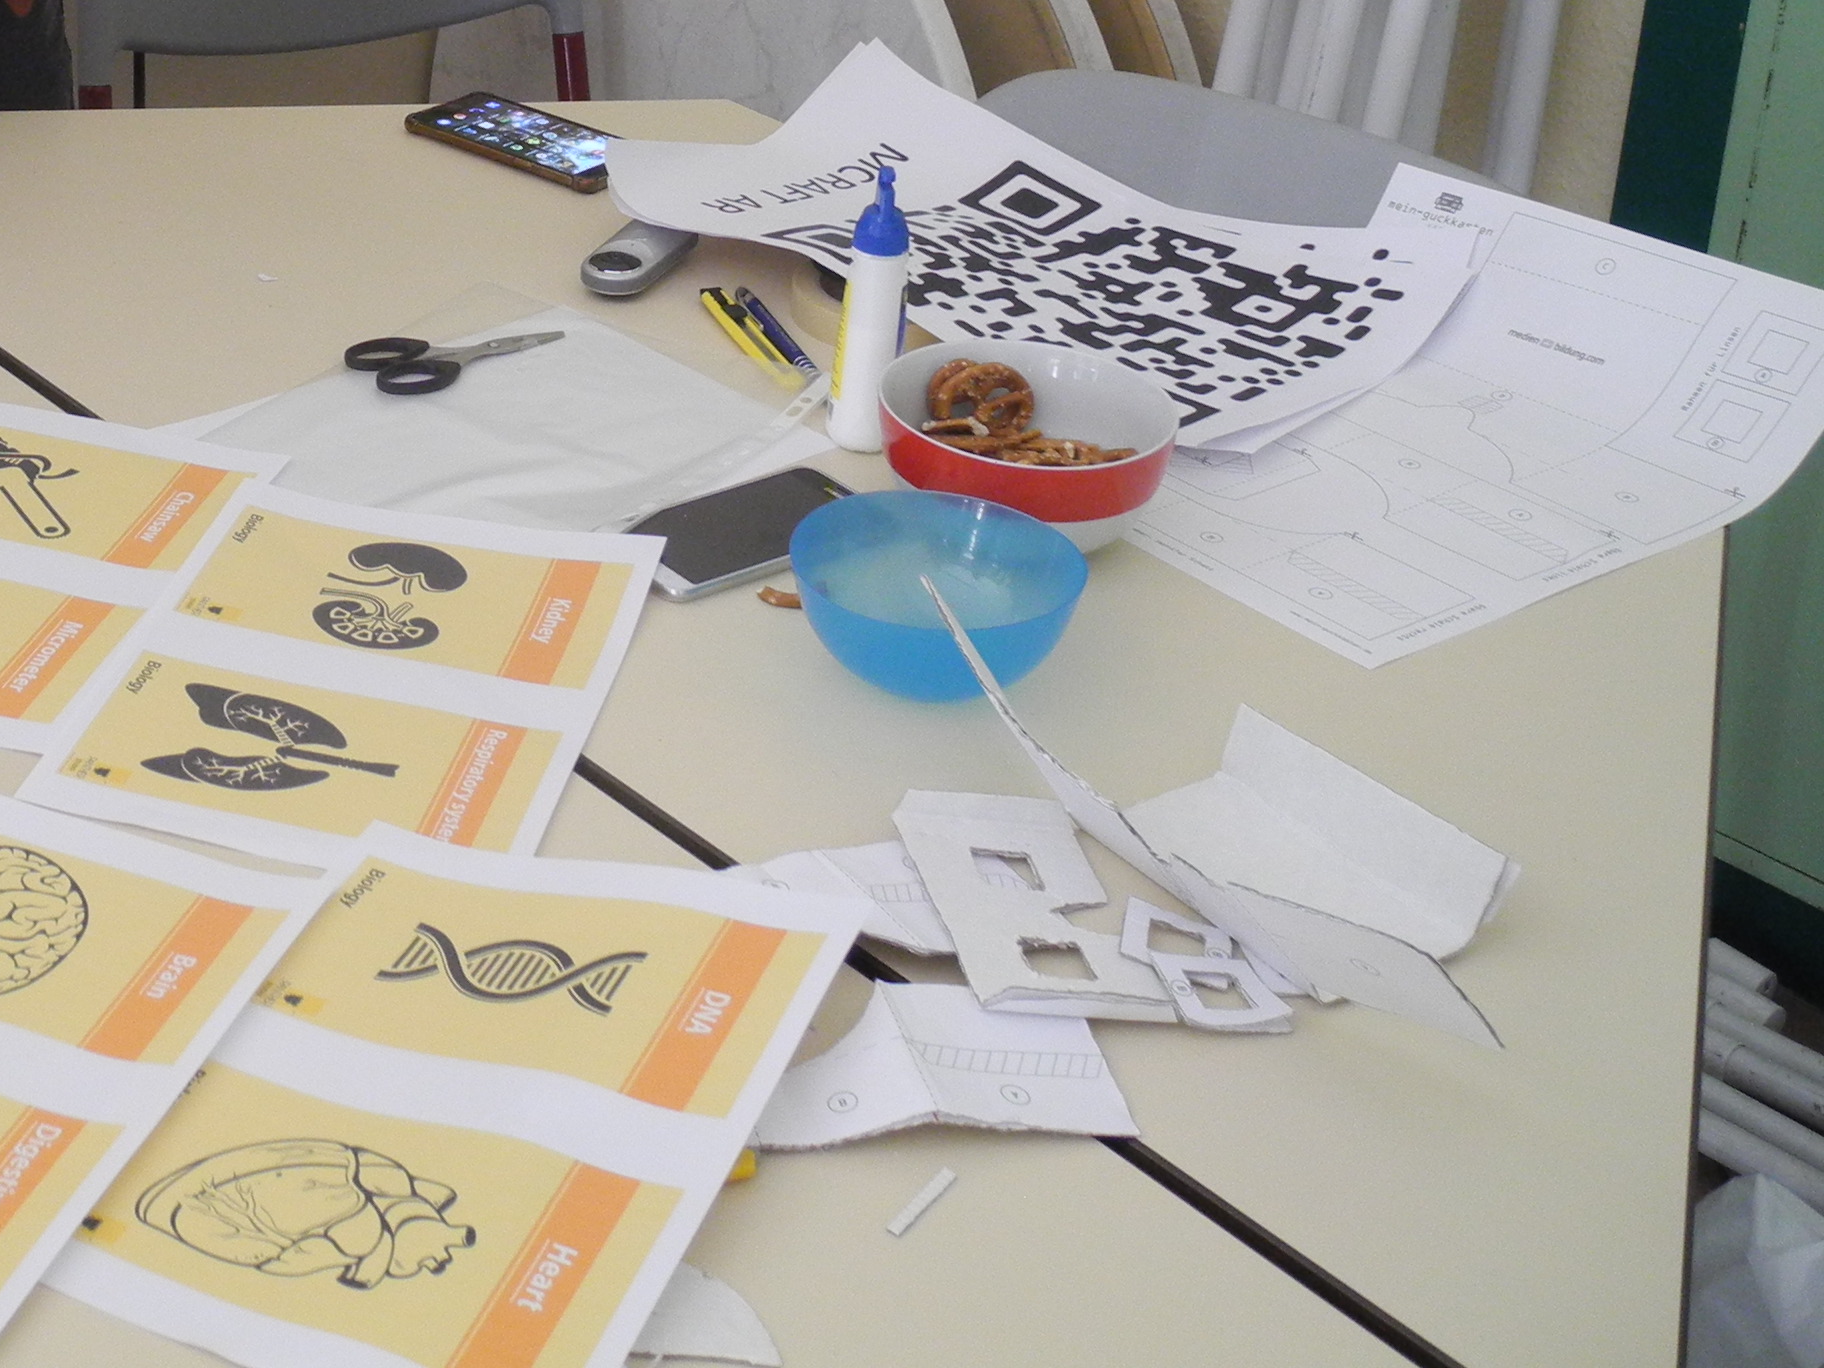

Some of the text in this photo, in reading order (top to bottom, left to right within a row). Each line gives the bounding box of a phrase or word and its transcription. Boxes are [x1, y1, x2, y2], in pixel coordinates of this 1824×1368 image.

[700, 193, 762, 214] AR
[1716, 326, 1741, 358] Linsen
[141, 491, 195, 543] Chainsaw
[232, 513, 264, 543] Biology
[531, 597, 572, 644] Kidney
[10, 620, 84, 693] Micrometer
[126, 660, 162, 694] Biology
[452, 729, 507, 802] Respiratory
[339, 867, 387, 909] Biology
[146, 952, 197, 999] Brain
[685, 990, 732, 1035] DNA
[516, 1242, 578, 1313] Heart
